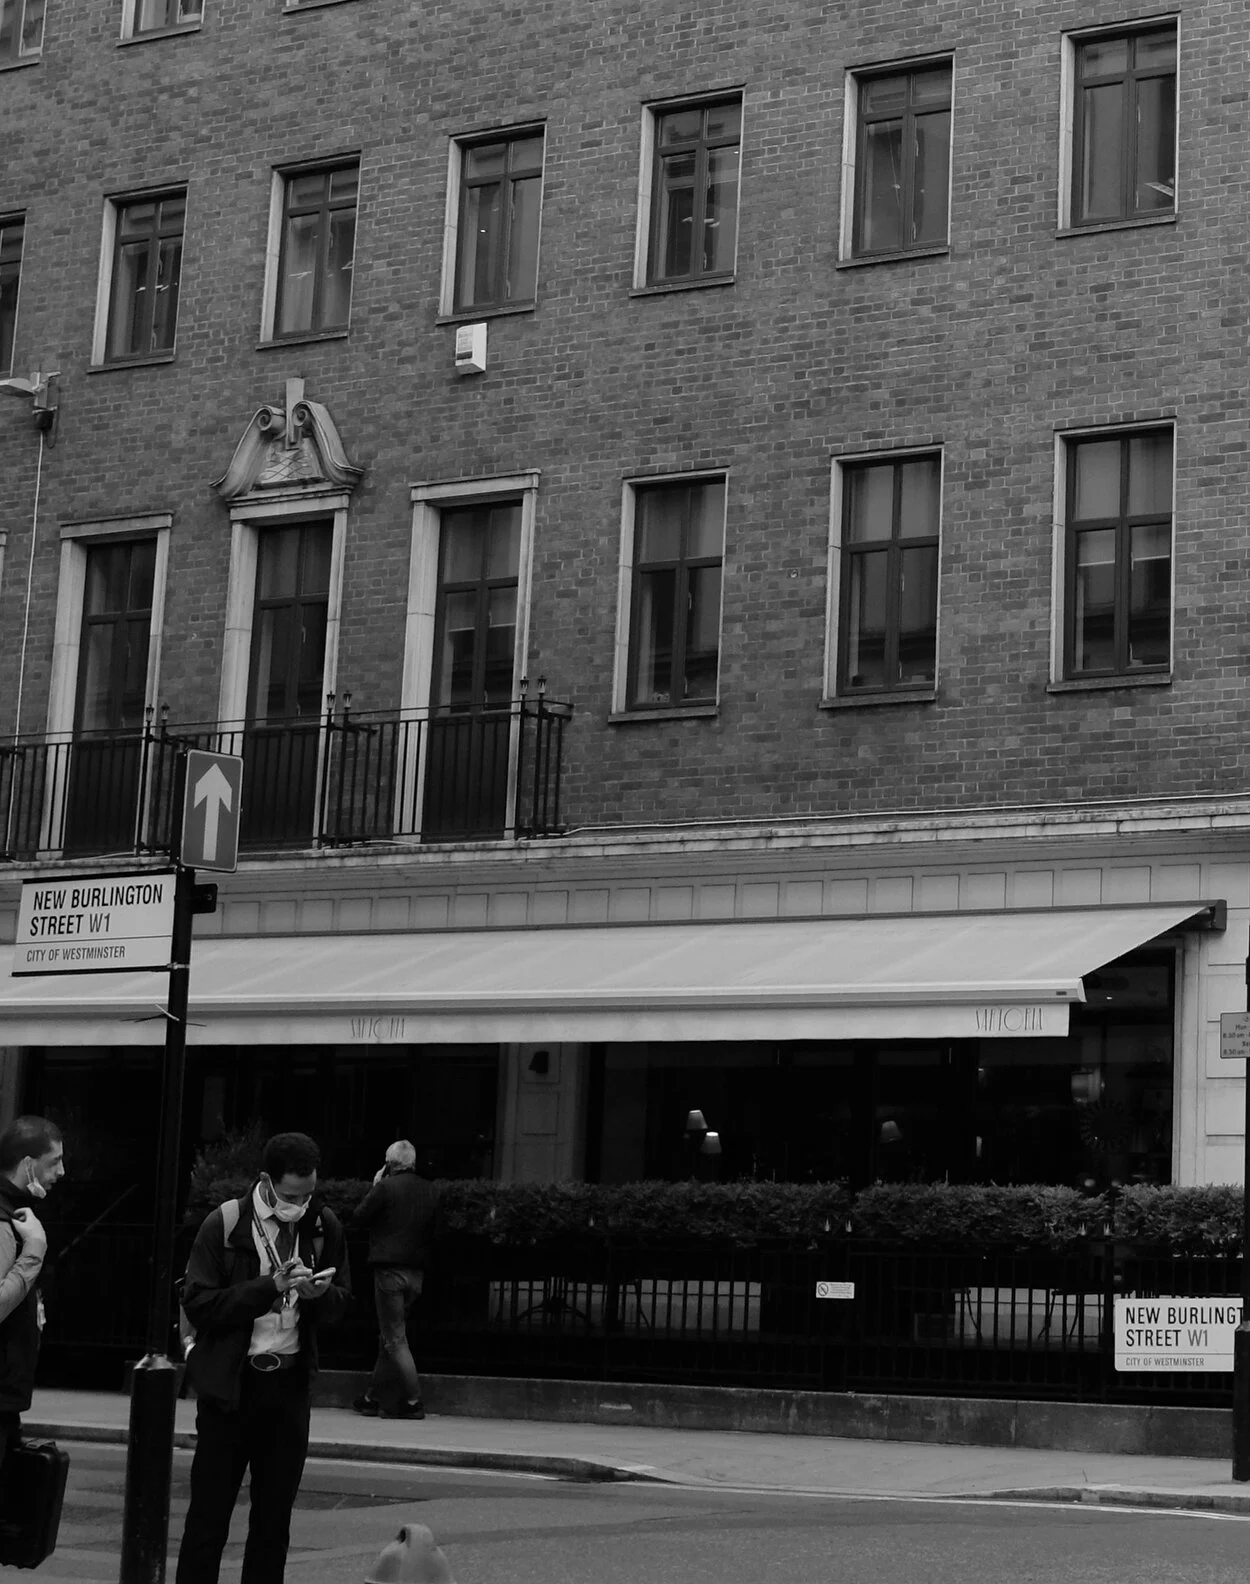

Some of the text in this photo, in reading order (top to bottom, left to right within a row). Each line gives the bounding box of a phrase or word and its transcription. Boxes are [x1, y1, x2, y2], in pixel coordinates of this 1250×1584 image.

[33, 884, 163, 911] NEW BURLINGTON
[30, 913, 111, 936] STREET W1
[26, 945, 126, 962] CITY OF WESTMINSTER
[1126, 1307, 1160, 1325] NEW
[1126, 1329, 1208, 1347] STREET W1
[1125, 1357, 1205, 1366] CITY OF WESTMINSTER
